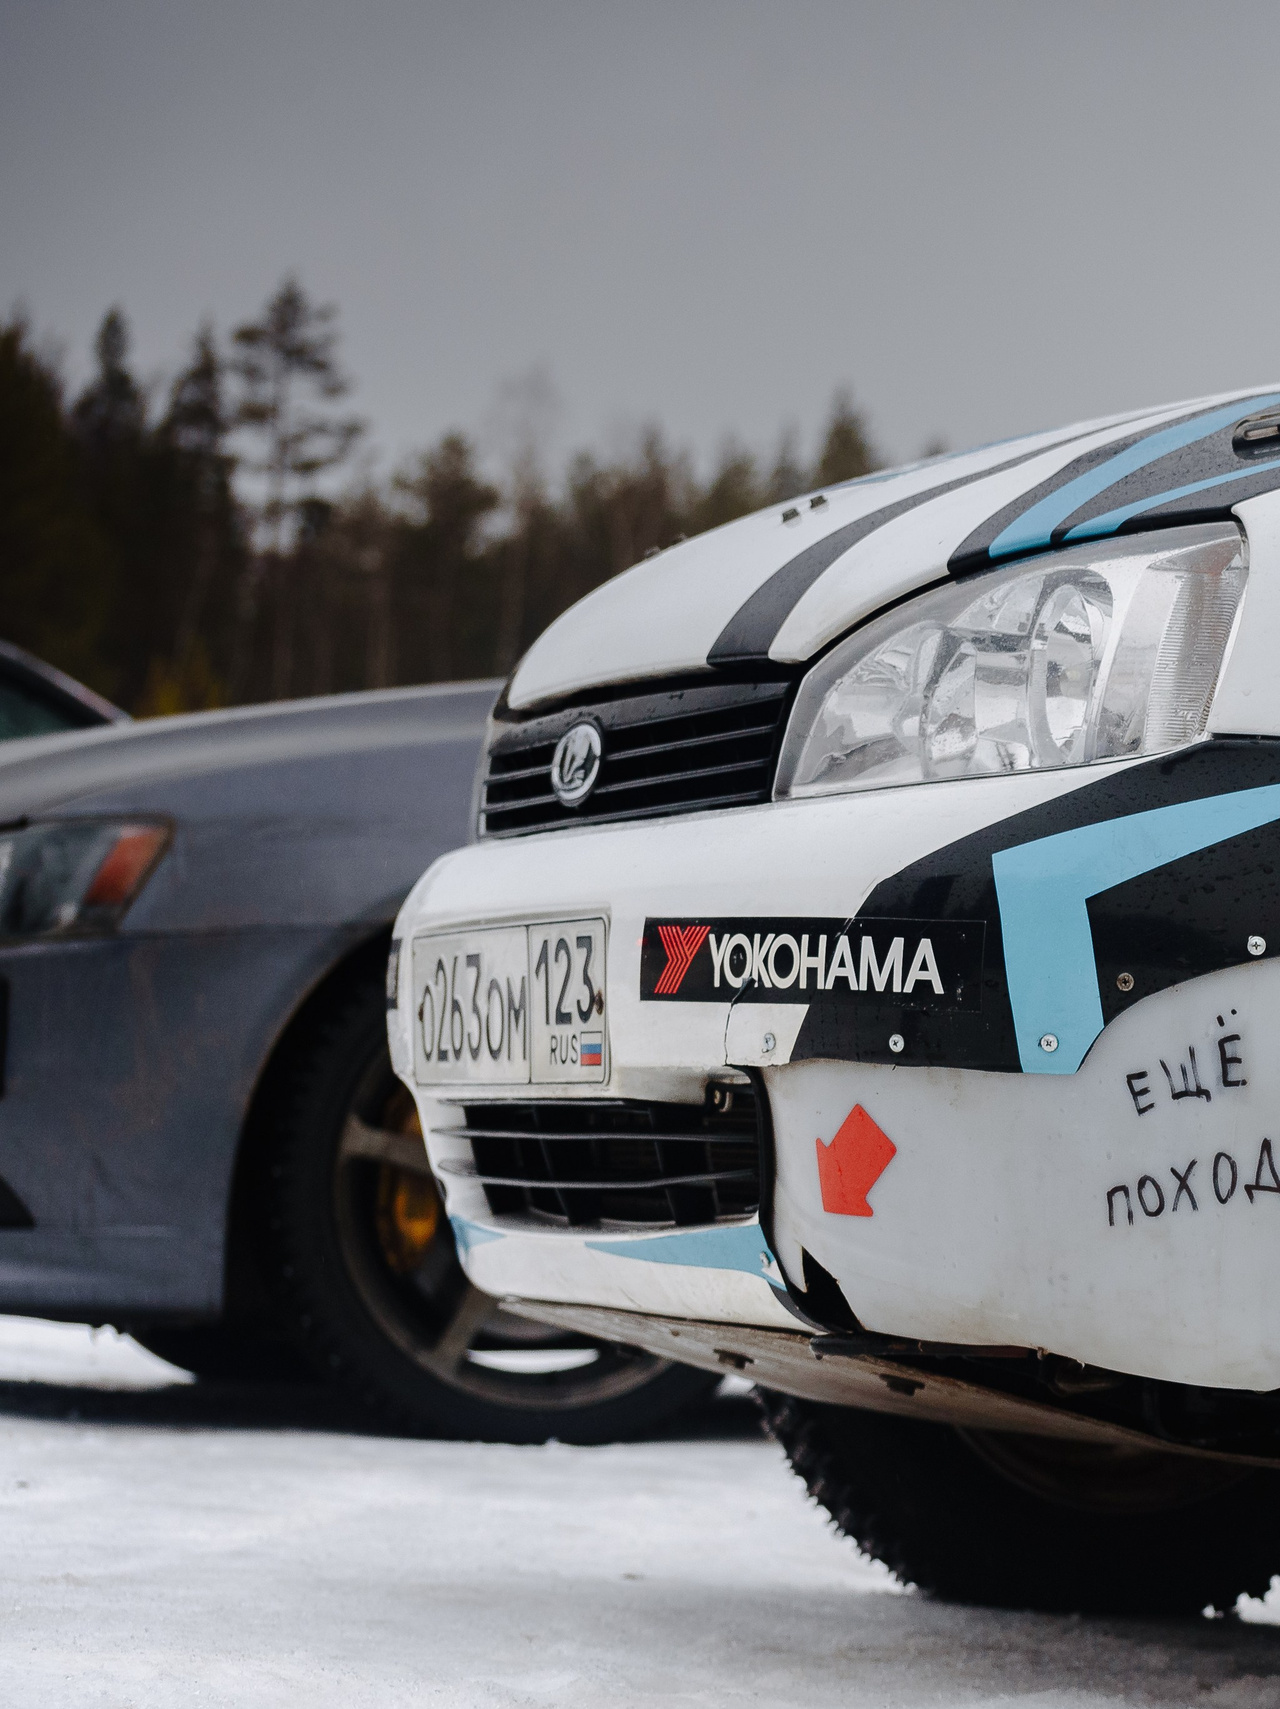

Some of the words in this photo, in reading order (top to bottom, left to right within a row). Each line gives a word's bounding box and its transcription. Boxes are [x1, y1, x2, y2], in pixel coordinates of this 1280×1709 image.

[535, 935, 595, 1026] 123
[708, 933, 944, 994] YOKOHAMA
[551, 1034, 578, 1065] RUS
[1126, 1008, 1248, 1116] ЕЩЁ
